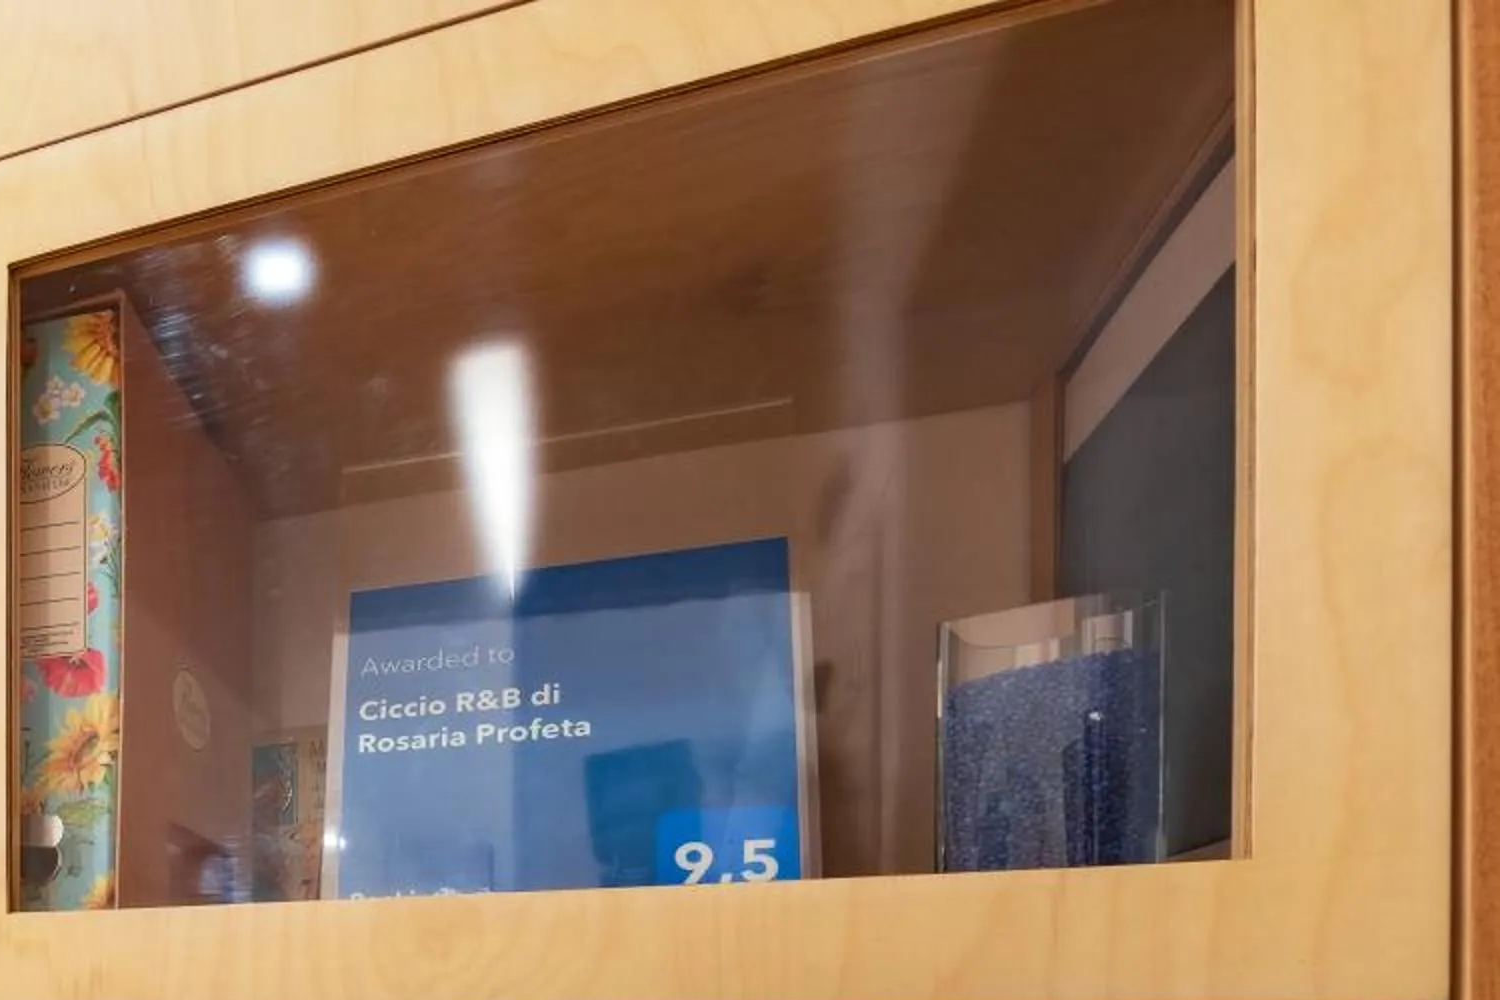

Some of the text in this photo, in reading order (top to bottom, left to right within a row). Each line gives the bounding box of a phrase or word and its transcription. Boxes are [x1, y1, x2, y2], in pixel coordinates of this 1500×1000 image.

[361, 646, 516, 678] Awarded to
[358, 683, 561, 721] Ciccio R&B di
[358, 718, 591, 754] Rosaria Profeta
